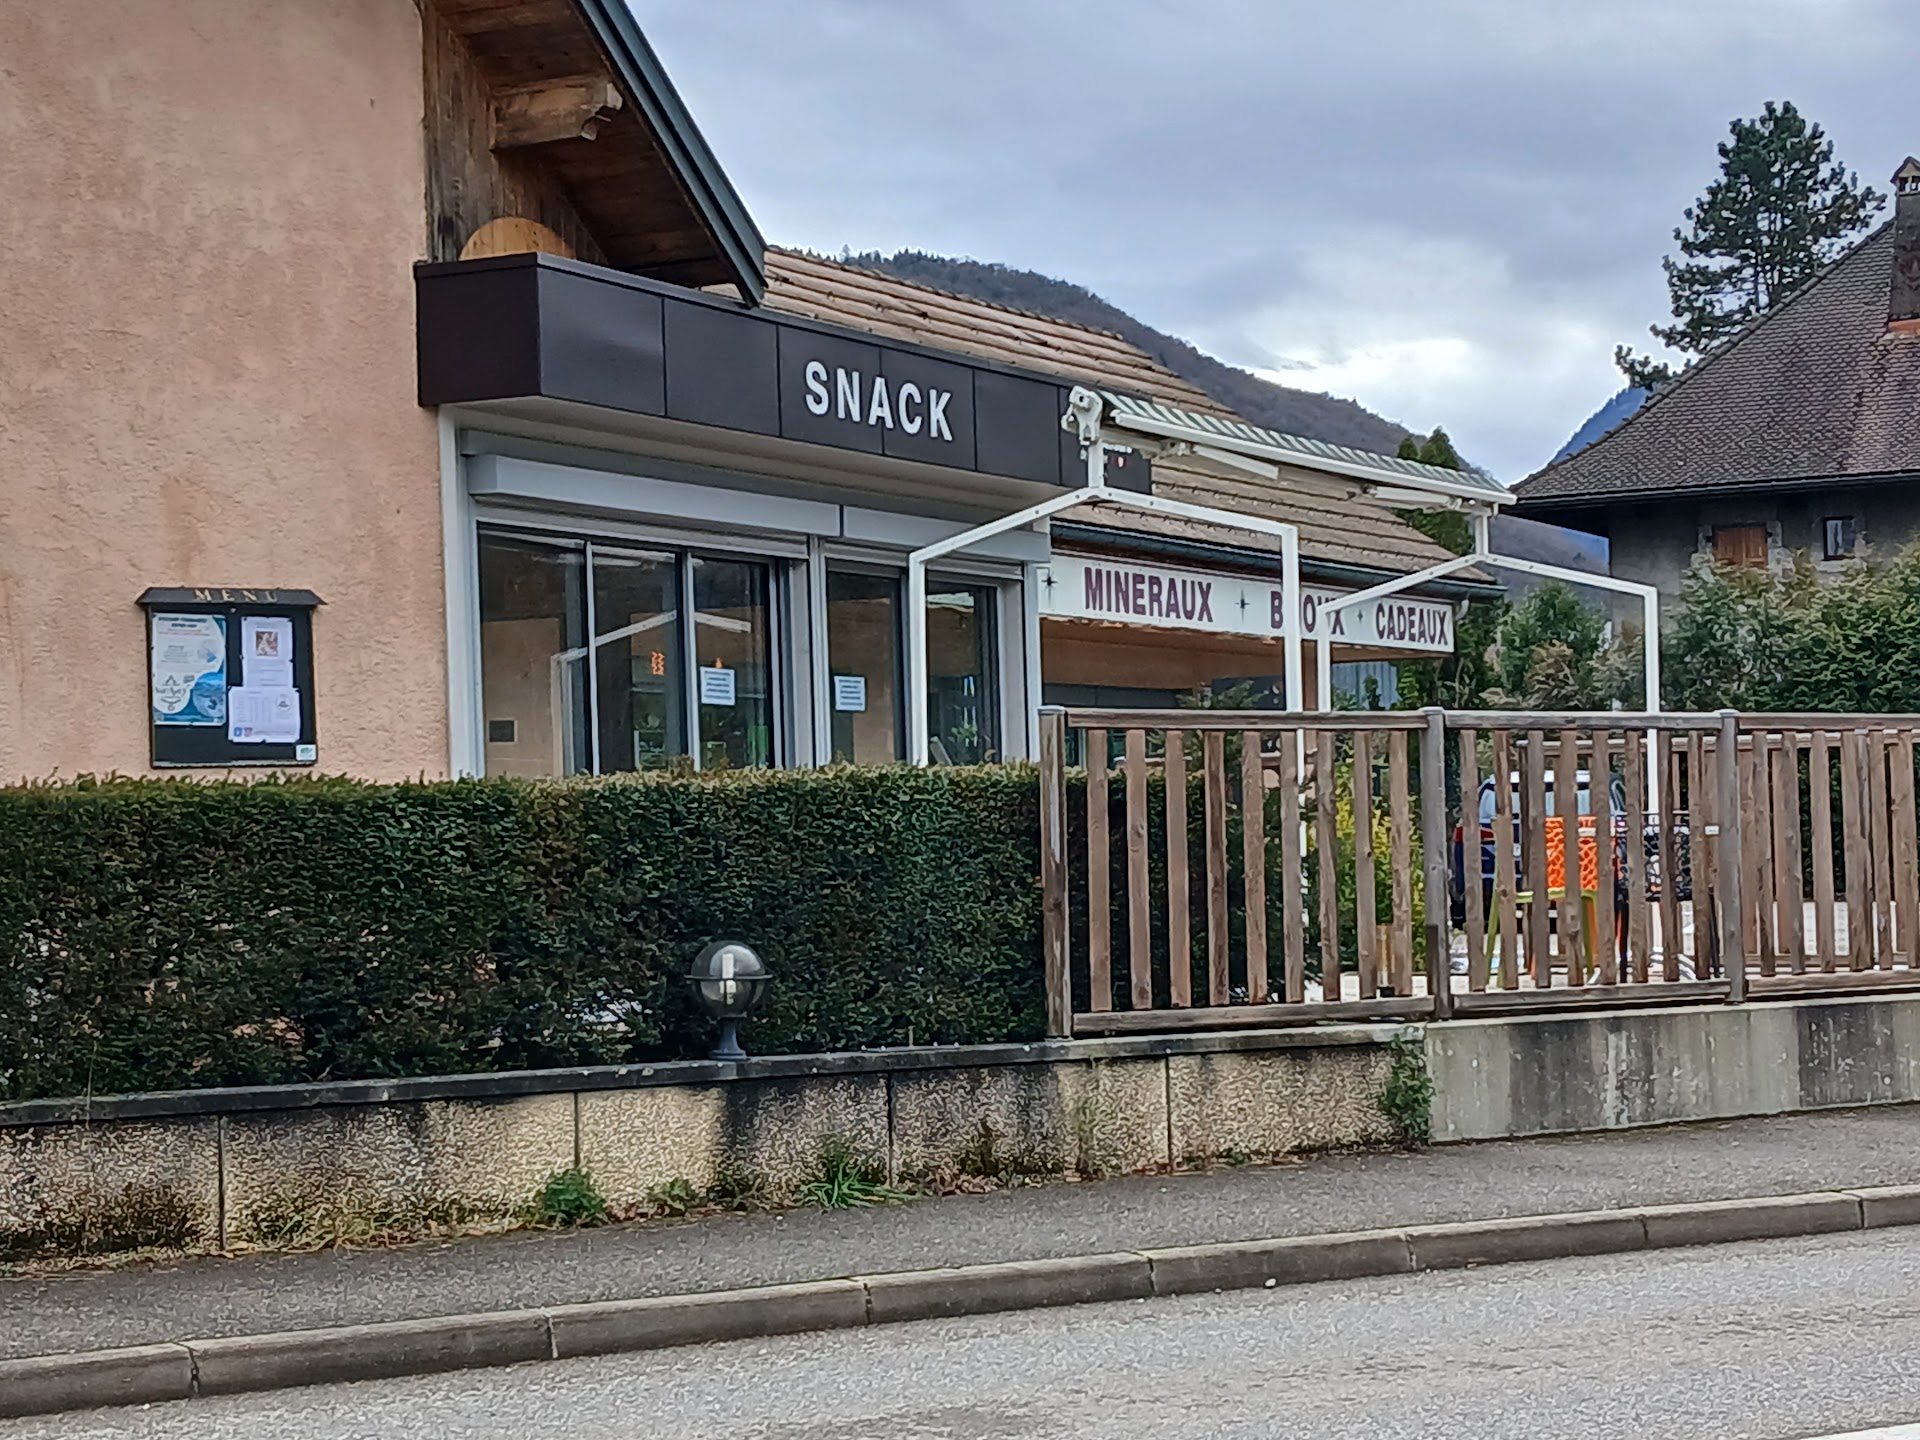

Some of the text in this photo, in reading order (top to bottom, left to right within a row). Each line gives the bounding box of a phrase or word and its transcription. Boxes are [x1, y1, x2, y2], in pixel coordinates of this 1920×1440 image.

[804, 360, 953, 442] SNACK
[193, 589, 277, 602] MENU
[1084, 566, 1449, 646] MINERAUX BOX CADEAUX
